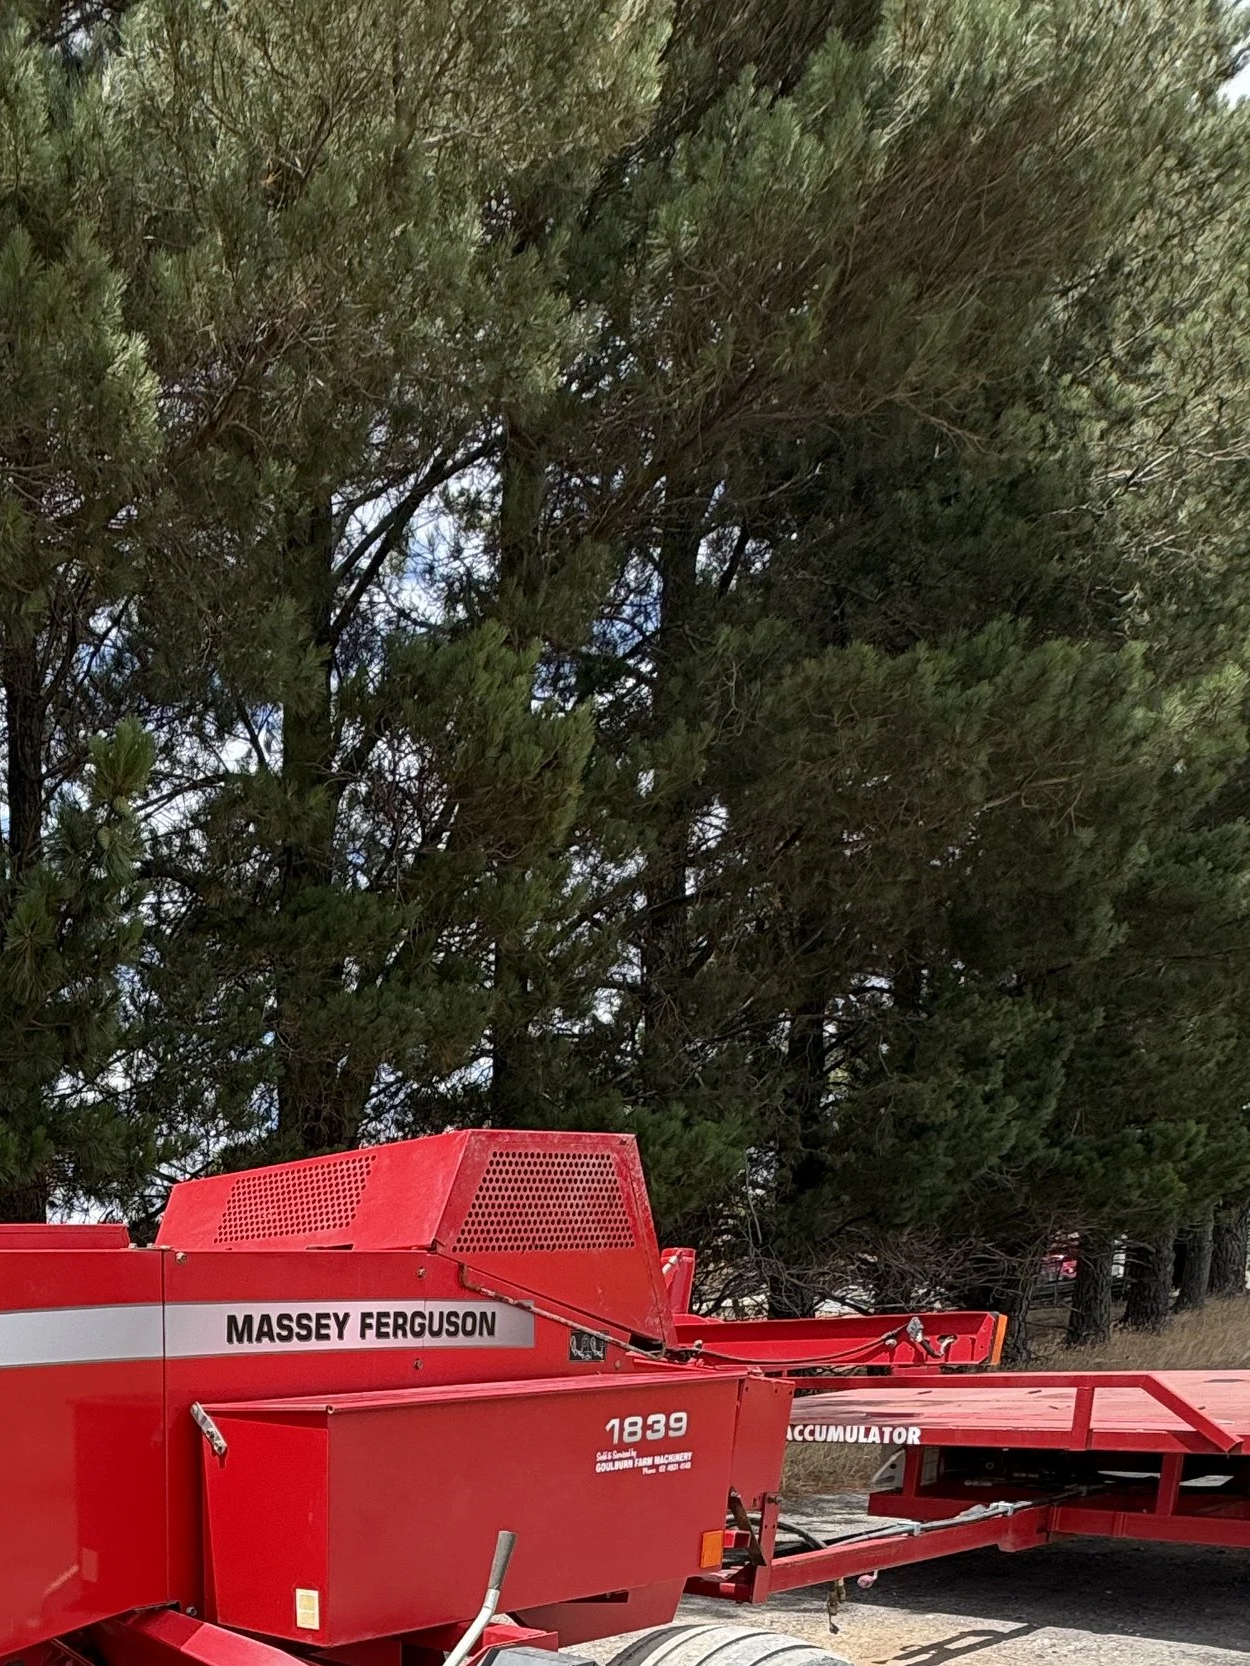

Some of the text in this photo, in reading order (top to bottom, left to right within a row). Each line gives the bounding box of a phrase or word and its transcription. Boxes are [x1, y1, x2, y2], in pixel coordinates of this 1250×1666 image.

[226, 1310, 496, 1344] MASSEY FERGUSON
[605, 1411, 688, 1445] 1839
[595, 1459, 633, 1474] GOULBURN
[634, 1456, 653, 1468] FARM
[654, 1451, 693, 1465] MACHINERY
